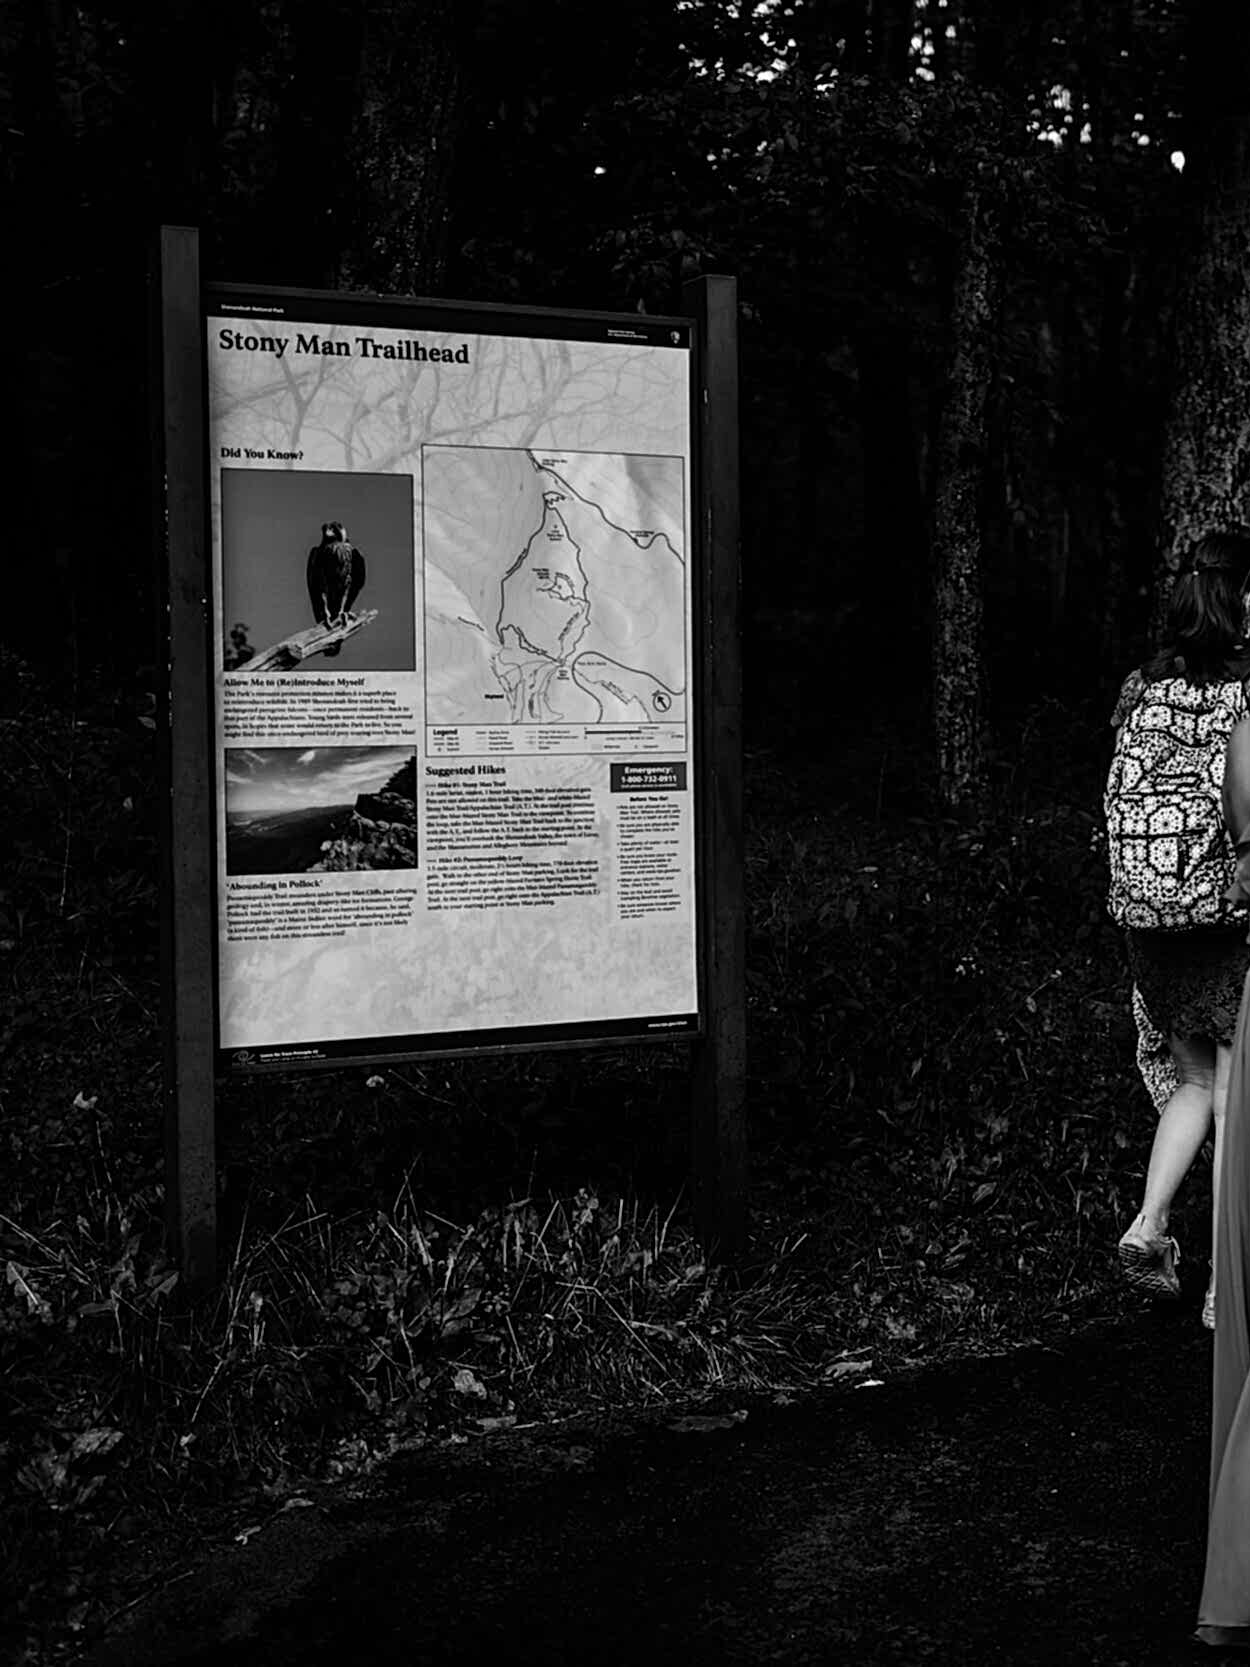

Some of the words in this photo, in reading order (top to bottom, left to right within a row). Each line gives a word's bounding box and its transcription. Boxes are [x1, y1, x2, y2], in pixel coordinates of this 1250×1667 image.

[219, 329, 289, 358] Stony
[295, 333, 350, 356] Man
[356, 337, 470, 363] Trailhead
[220, 448, 241, 458] Did
[244, 449, 264, 459] You
[267, 450, 304, 460] Know?
[223, 678, 248, 687] Allow
[250, 678, 264, 686] Me
[336, 678, 364, 686] Myself
[432, 728, 458, 736] Legend
[425, 765, 475, 777] Suggested
[477, 764, 505, 774] Hikes
